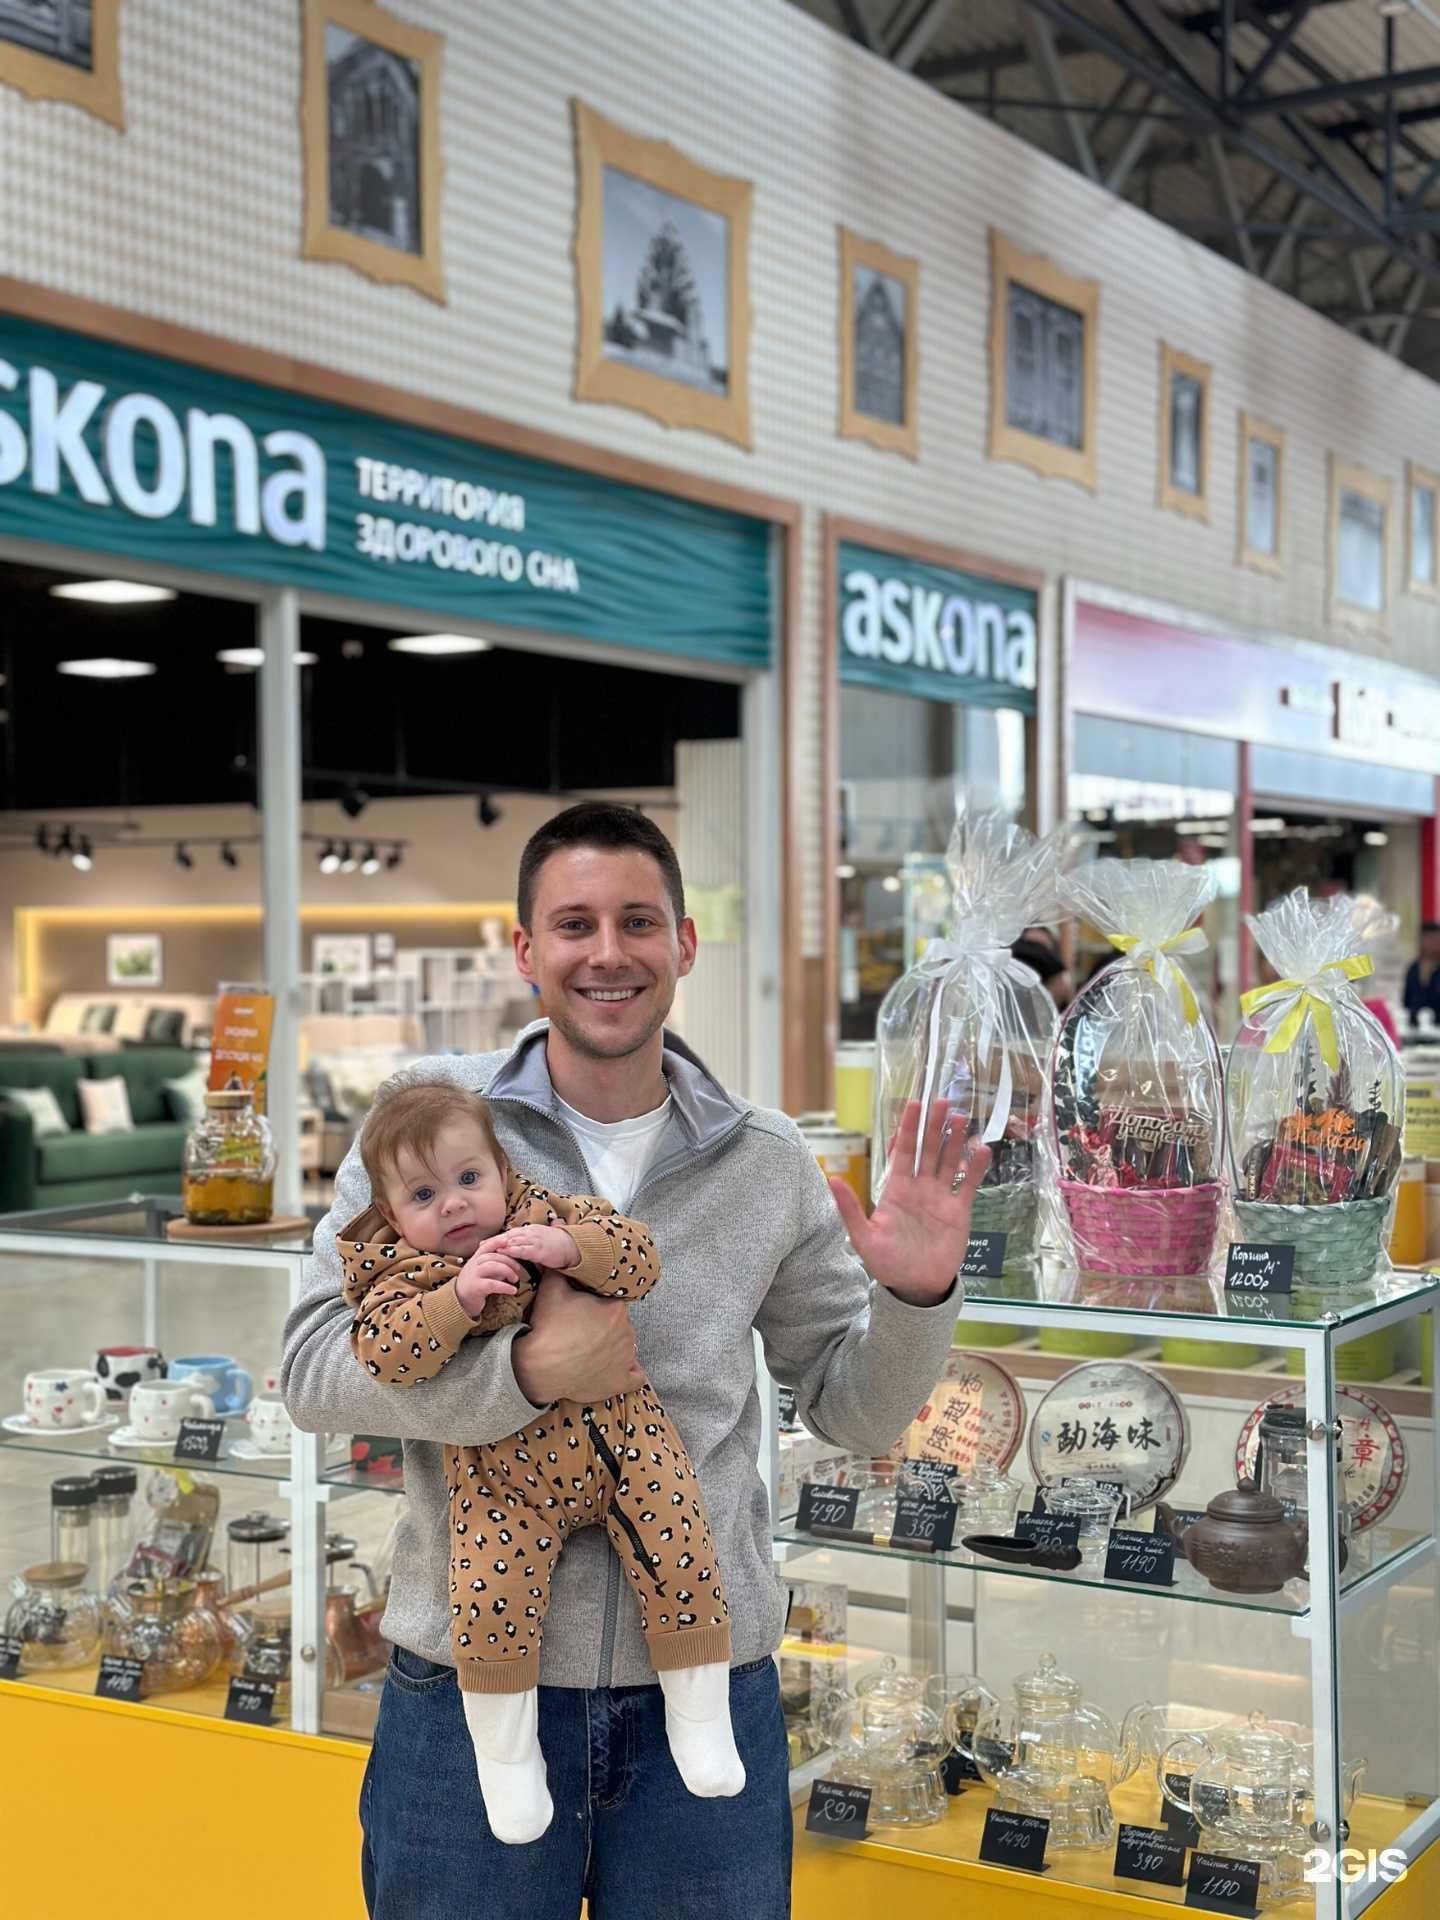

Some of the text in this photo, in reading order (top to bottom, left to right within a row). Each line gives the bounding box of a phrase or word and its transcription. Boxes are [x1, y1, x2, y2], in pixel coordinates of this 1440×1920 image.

[355, 456, 525, 532] ТЕРРИТОРИЯ
[355, 512, 580, 594] ЗДОРОВОГО СНА
[843, 570, 1036, 690] askona
[1232, 1245, 1269, 1266] Корзина
[1056, 1415, 1161, 1454] 勐海味
[810, 1501, 847, 1523] 490
[906, 1518, 936, 1537] 350
[1120, 1553, 1157, 1574] 1190
[1132, 1852, 1164, 1876] 390
[1200, 1876, 1241, 1897] 1190
